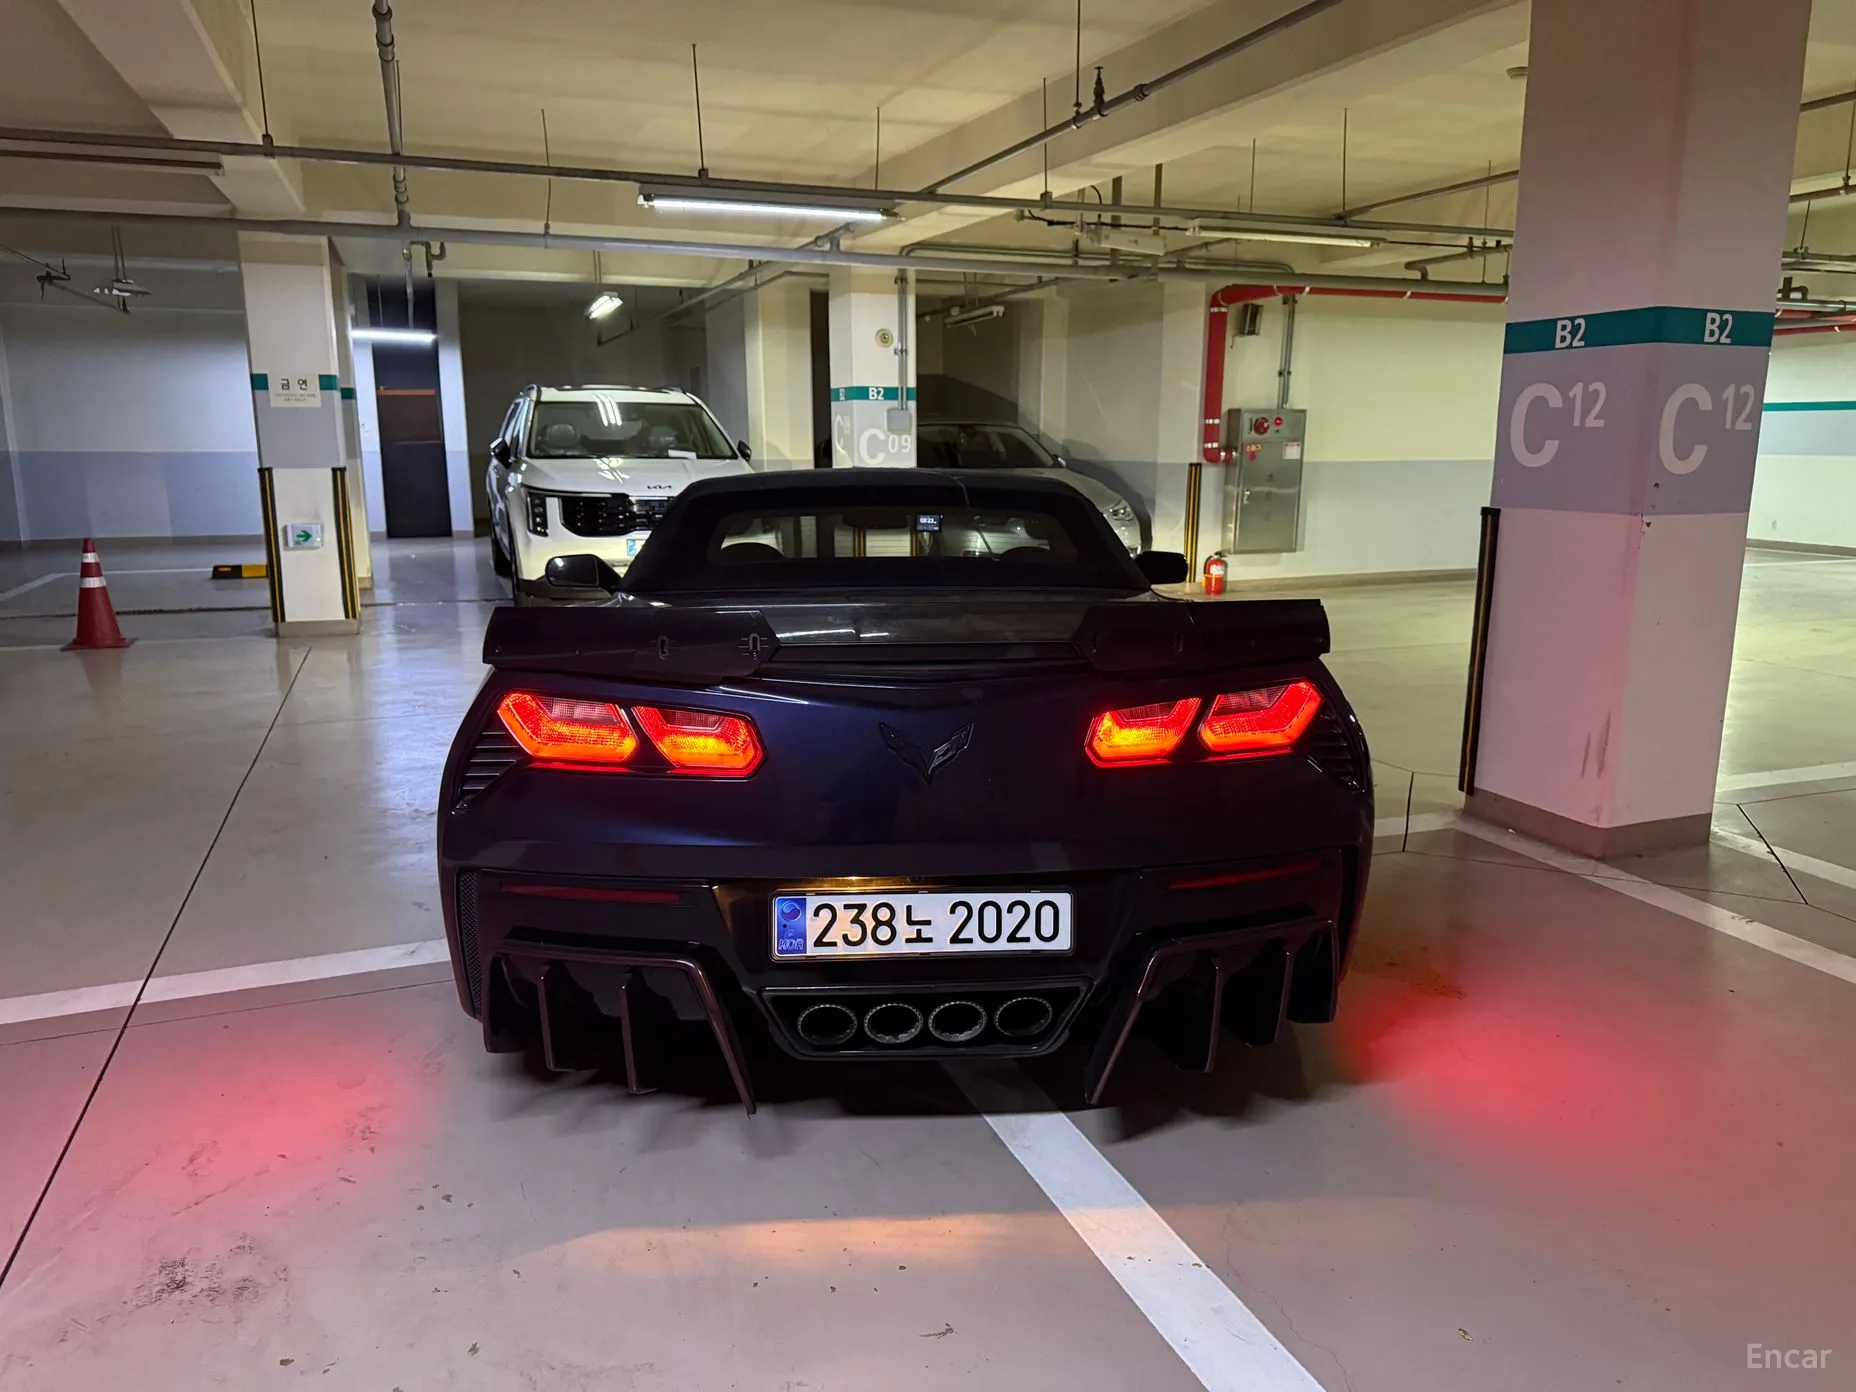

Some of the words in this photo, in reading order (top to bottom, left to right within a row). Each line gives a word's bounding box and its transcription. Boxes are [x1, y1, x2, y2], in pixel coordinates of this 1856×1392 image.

[1554, 317, 1586, 349] B2
[1703, 311, 1733, 344] B2
[868, 387, 885, 401] B2
[813, 901, 934, 948] 238노
[948, 899, 1060, 945] 2020
